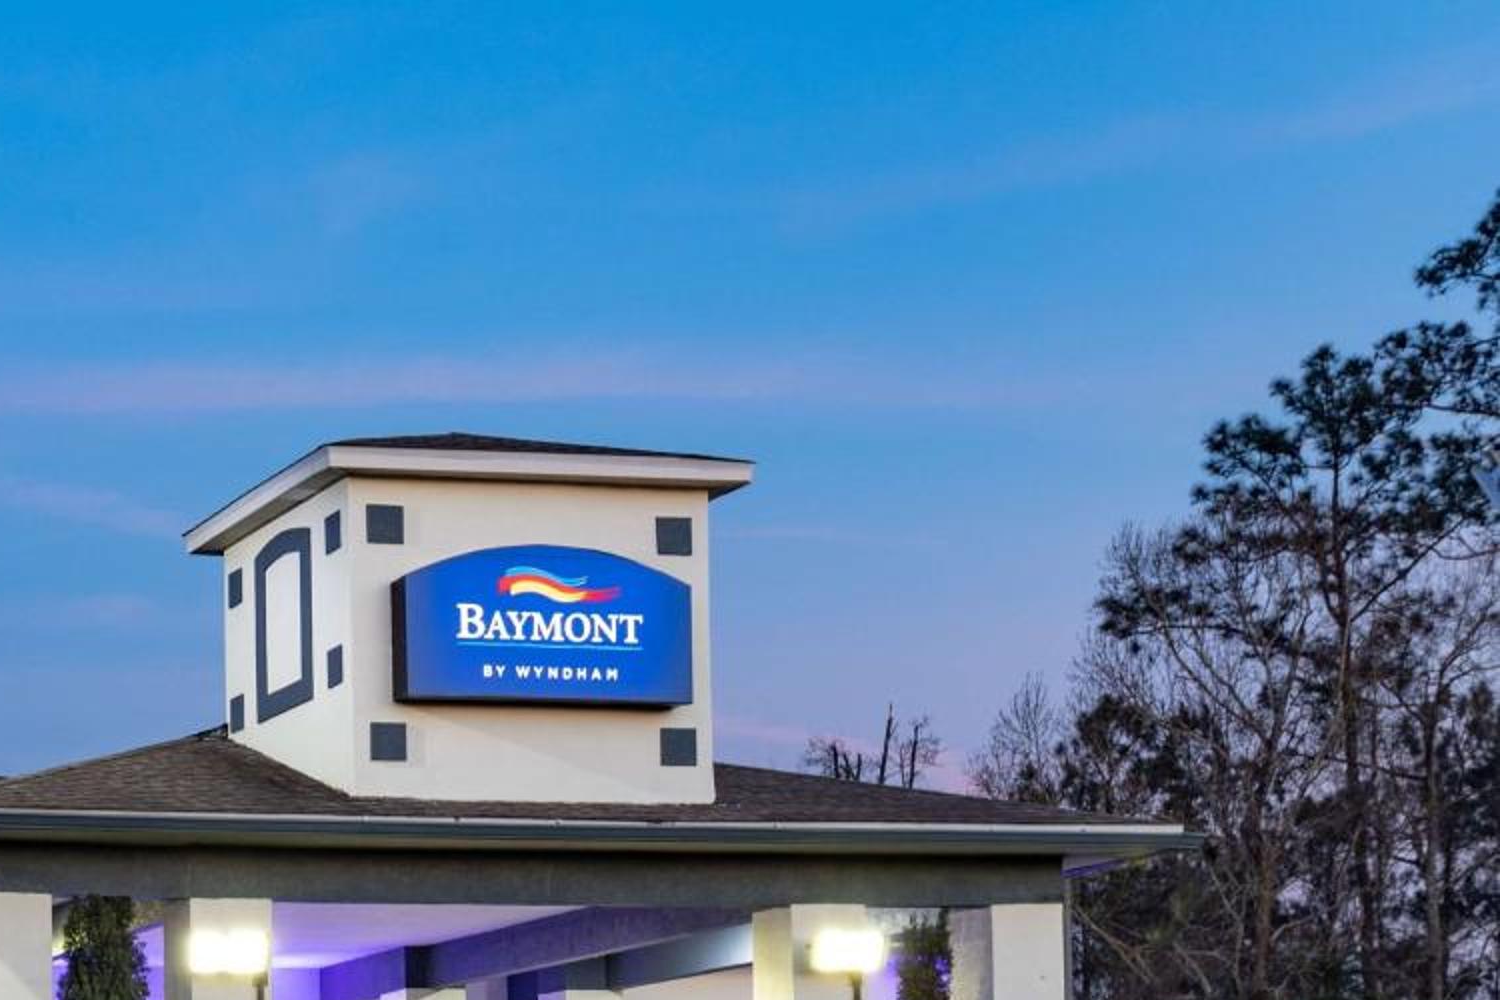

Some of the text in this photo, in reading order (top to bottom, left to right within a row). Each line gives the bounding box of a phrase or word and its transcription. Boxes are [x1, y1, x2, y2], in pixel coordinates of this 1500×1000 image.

[456, 603, 644, 644] BAYMONT
[483, 664, 619, 681] BY WYNDHAM
